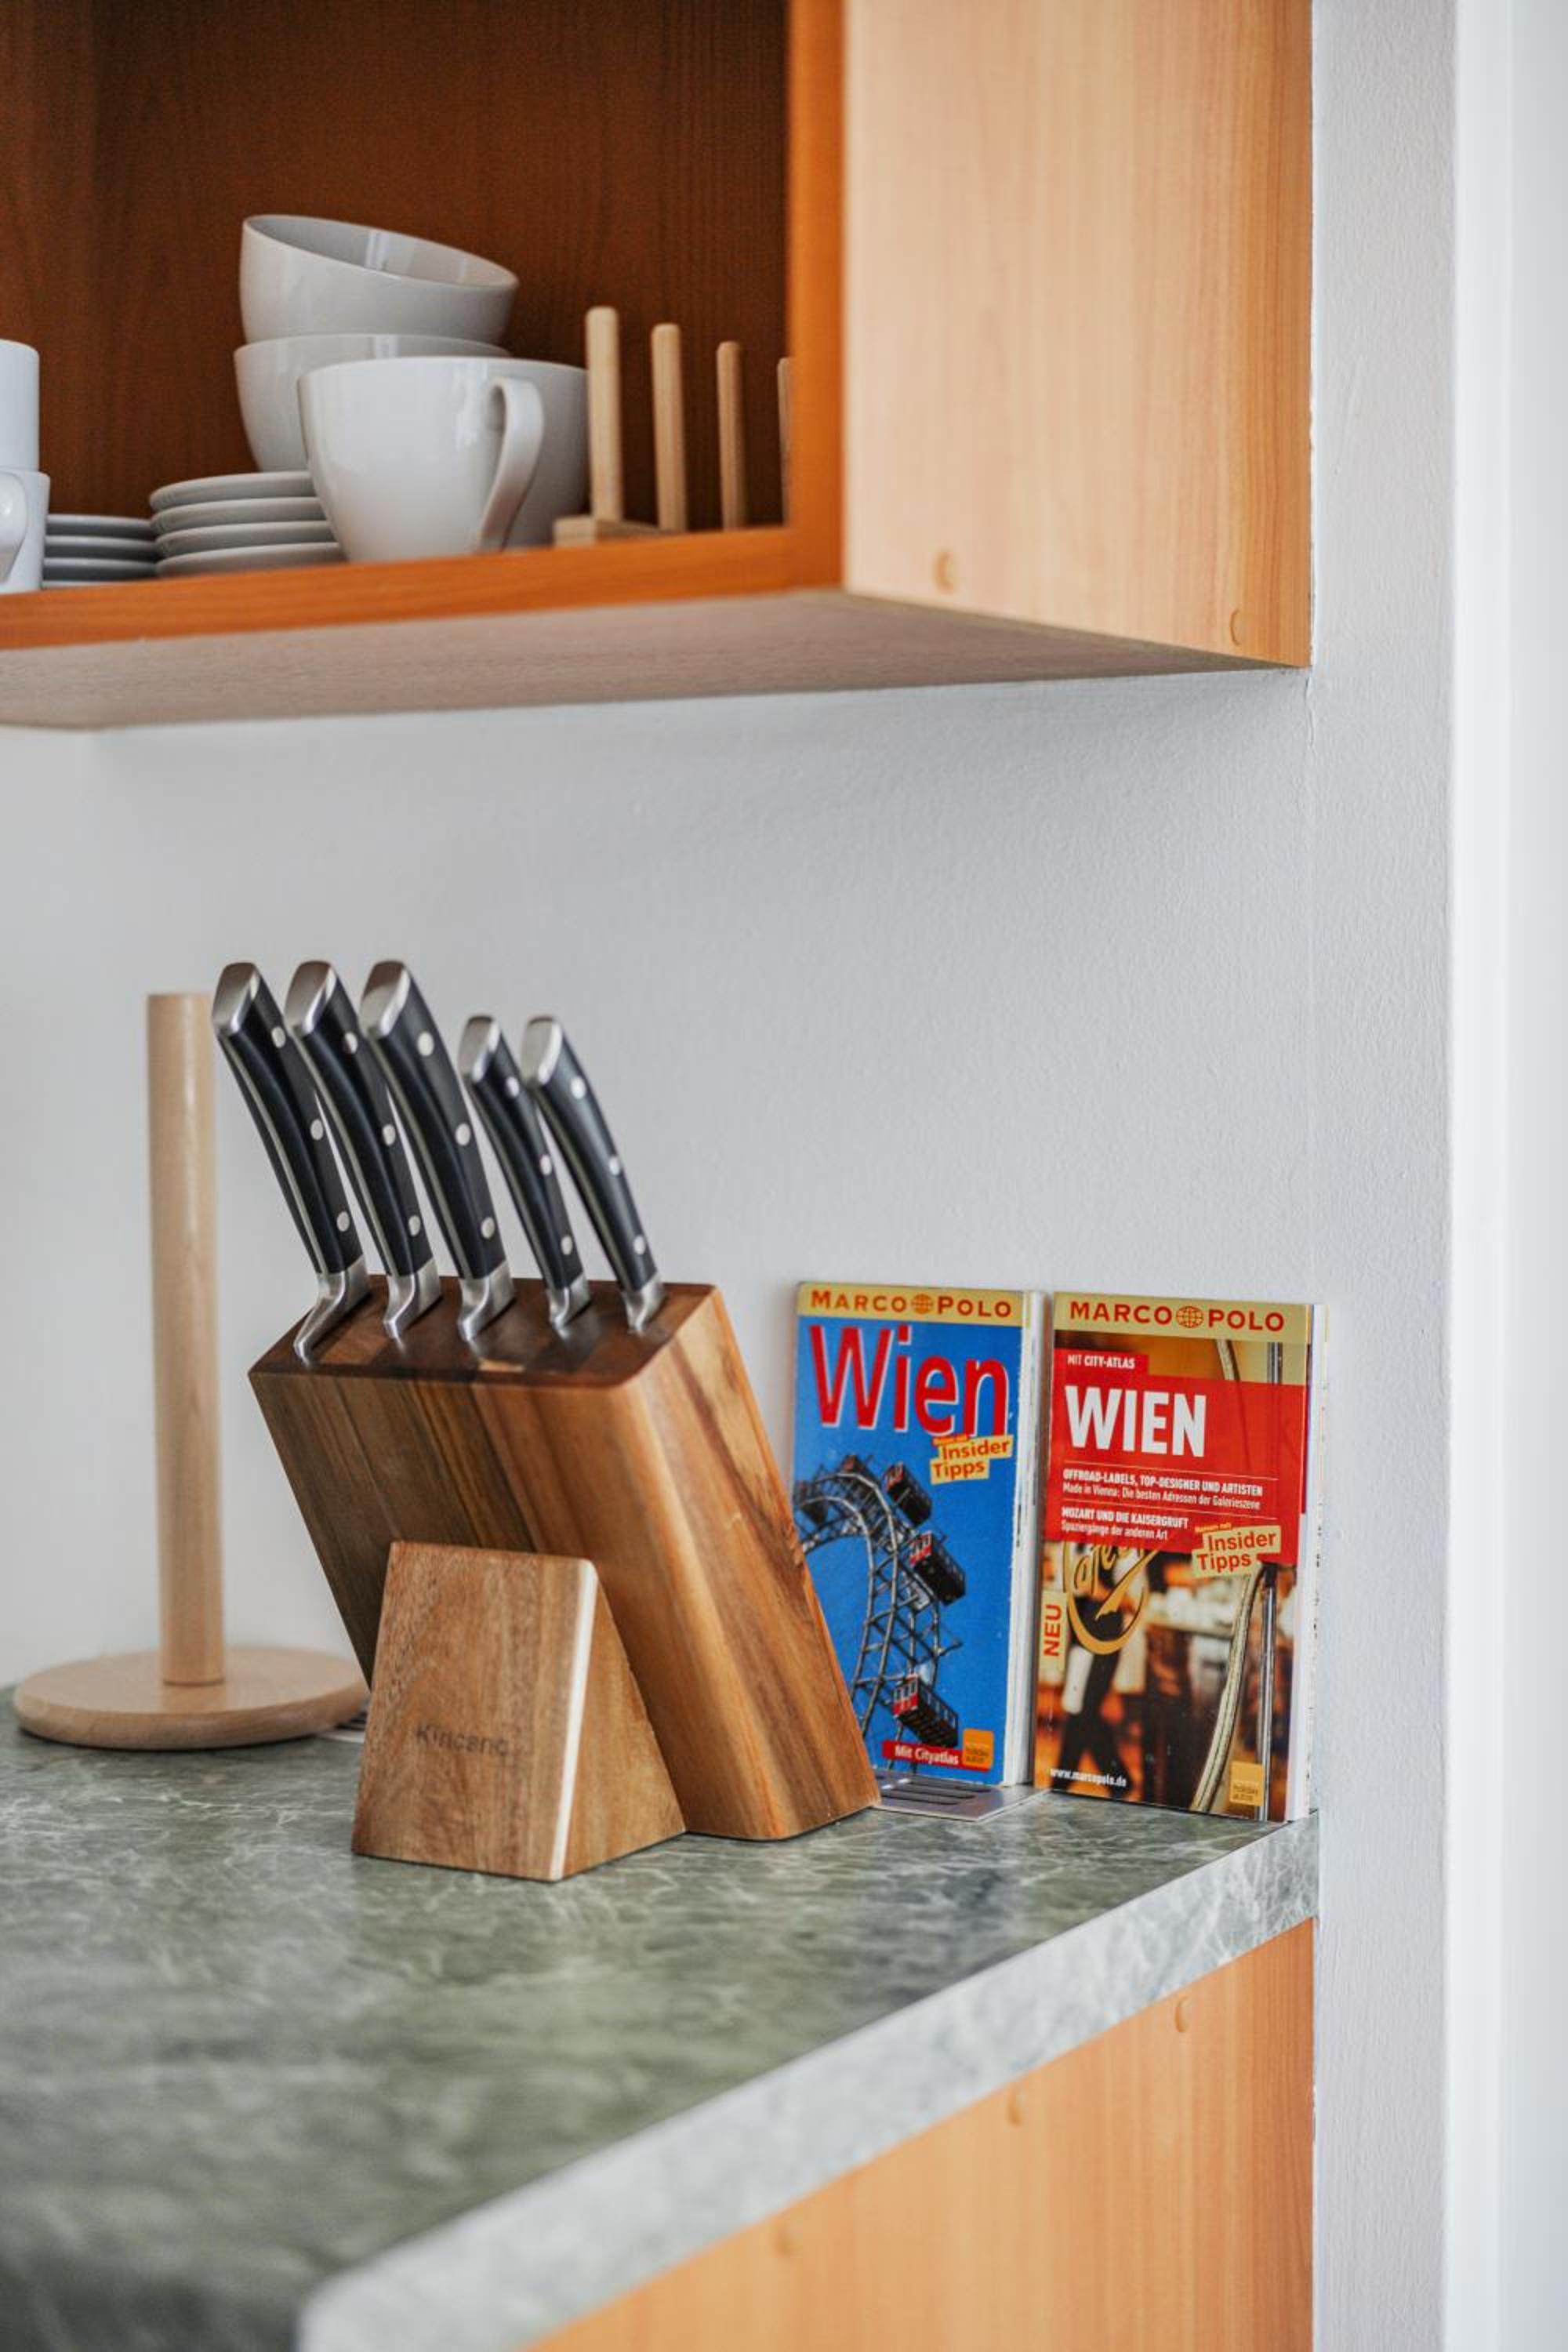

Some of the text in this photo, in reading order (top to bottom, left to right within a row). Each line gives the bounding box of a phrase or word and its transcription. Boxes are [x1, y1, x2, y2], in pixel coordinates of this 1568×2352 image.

[811, 1290, 1011, 1318] MARCO POLO
[1069, 1301, 1285, 1332] MARCO POLO
[1067, 1354, 1135, 1370] MIT CITY-ATLAS
[808, 1323, 1010, 1437] Wien
[1065, 1385, 1207, 1458] WIEN
[942, 1439, 1010, 1460] Insider
[932, 1461, 985, 1480] Tipps
[1062, 1468, 1263, 1497] OFFROAD-LABELS, TOP-DESIGNER UND ARTISTEN
[1135, 1487, 1161, 1501] besten
[1162, 1490, 1197, 1504] Adressen
[1198, 1494, 1210, 1505] der
[1062, 1505, 1095, 1520] MOZART
[1096, 1508, 1115, 1523] UND
[1116, 1510, 1130, 1524] DIE
[1131, 1512, 1189, 1530] KAISERGRUFT
[1110, 1523, 1123, 1536] der
[1124, 1526, 1155, 1539] anderen
[1156, 1528, 1168, 1541] Art
[1208, 1531, 1276, 1552] Insider
[1196, 1552, 1252, 1573] Tipps
[1044, 1604, 1062, 1657] NEU
[895, 1744, 913, 1759] Mit
[915, 1747, 960, 1766] Cityatlas
